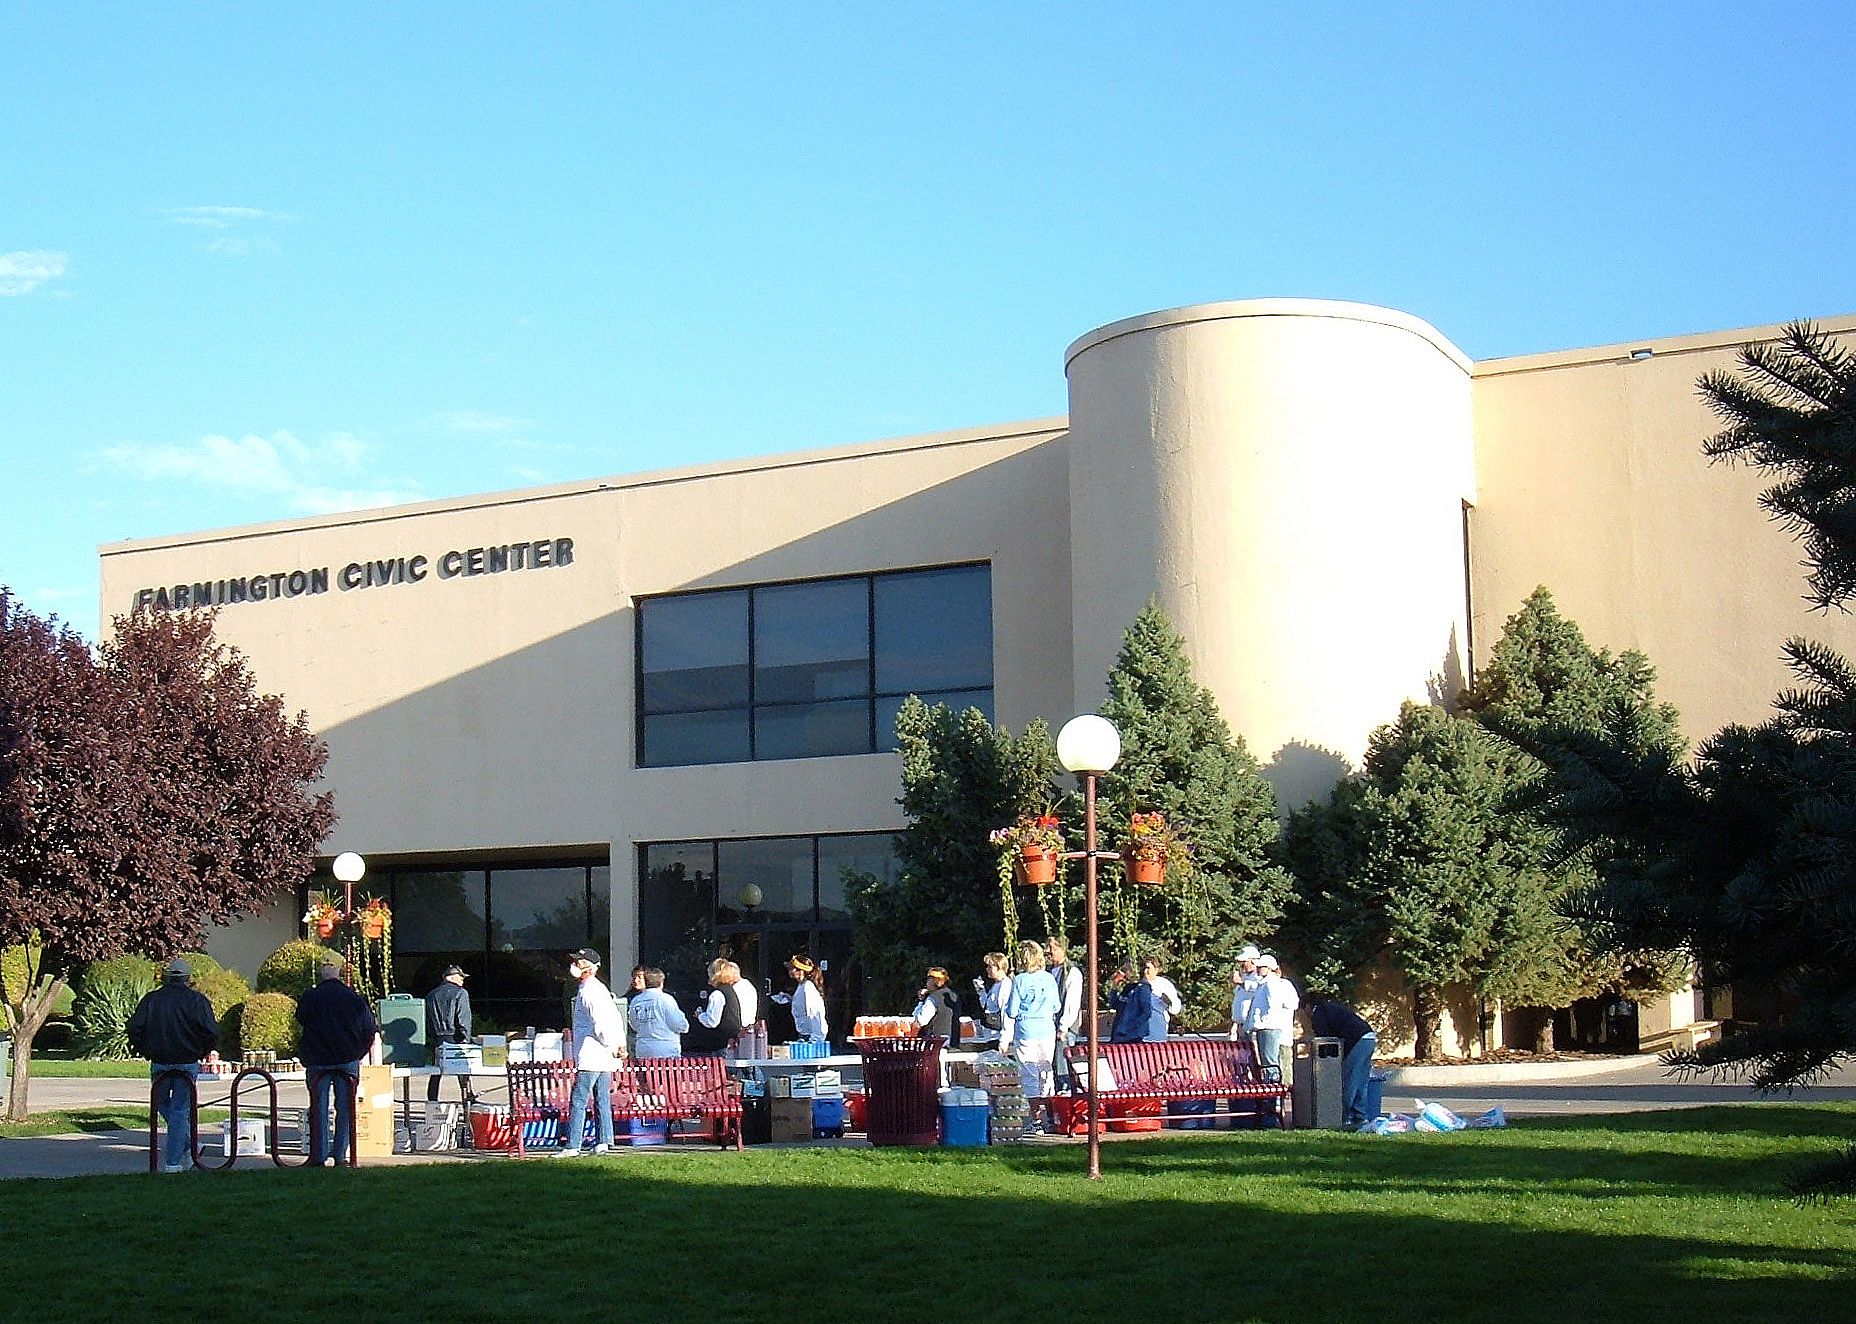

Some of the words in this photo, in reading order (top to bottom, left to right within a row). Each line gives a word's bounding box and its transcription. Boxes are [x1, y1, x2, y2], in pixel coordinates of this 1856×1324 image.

[137, 567, 328, 611] FARMINGTON
[340, 555, 428, 591] CIVIC
[439, 538, 575, 578] CENTER
